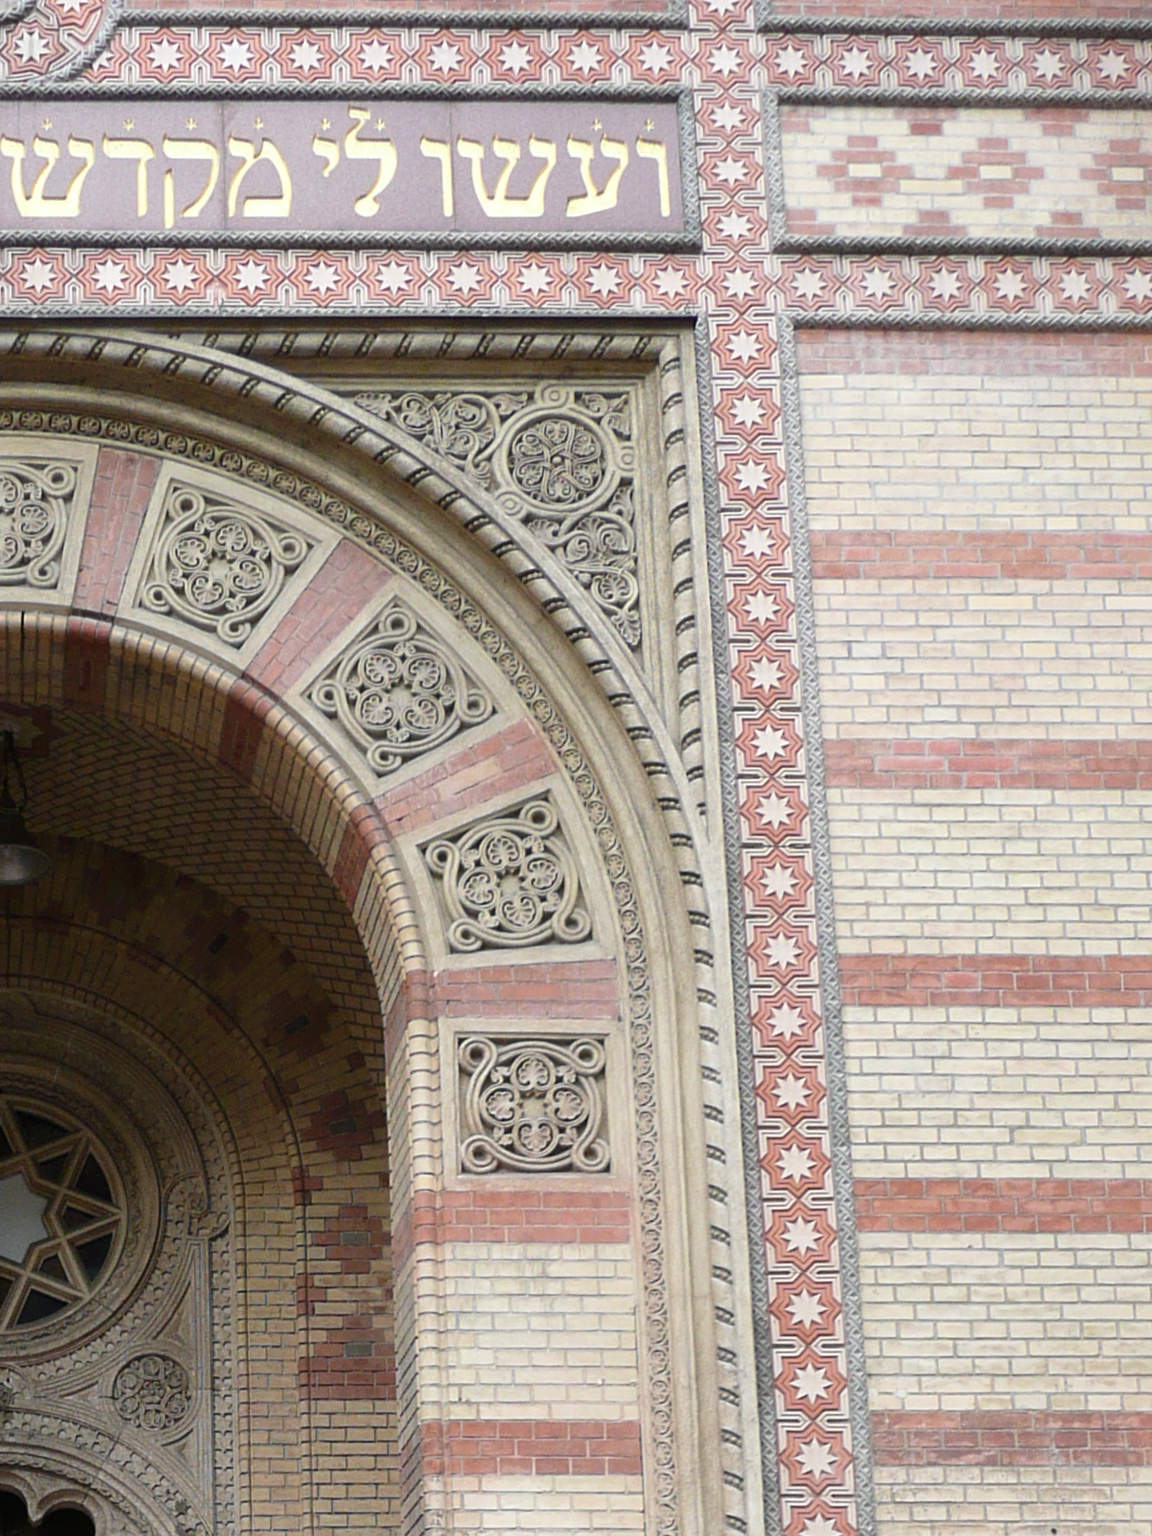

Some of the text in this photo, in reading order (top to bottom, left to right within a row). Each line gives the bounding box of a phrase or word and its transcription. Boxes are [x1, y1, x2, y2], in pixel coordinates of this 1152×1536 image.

[0, 132, 293, 229] מקדש
[312, 105, 398, 218] לי
[419, 132, 671, 218] ועשו
